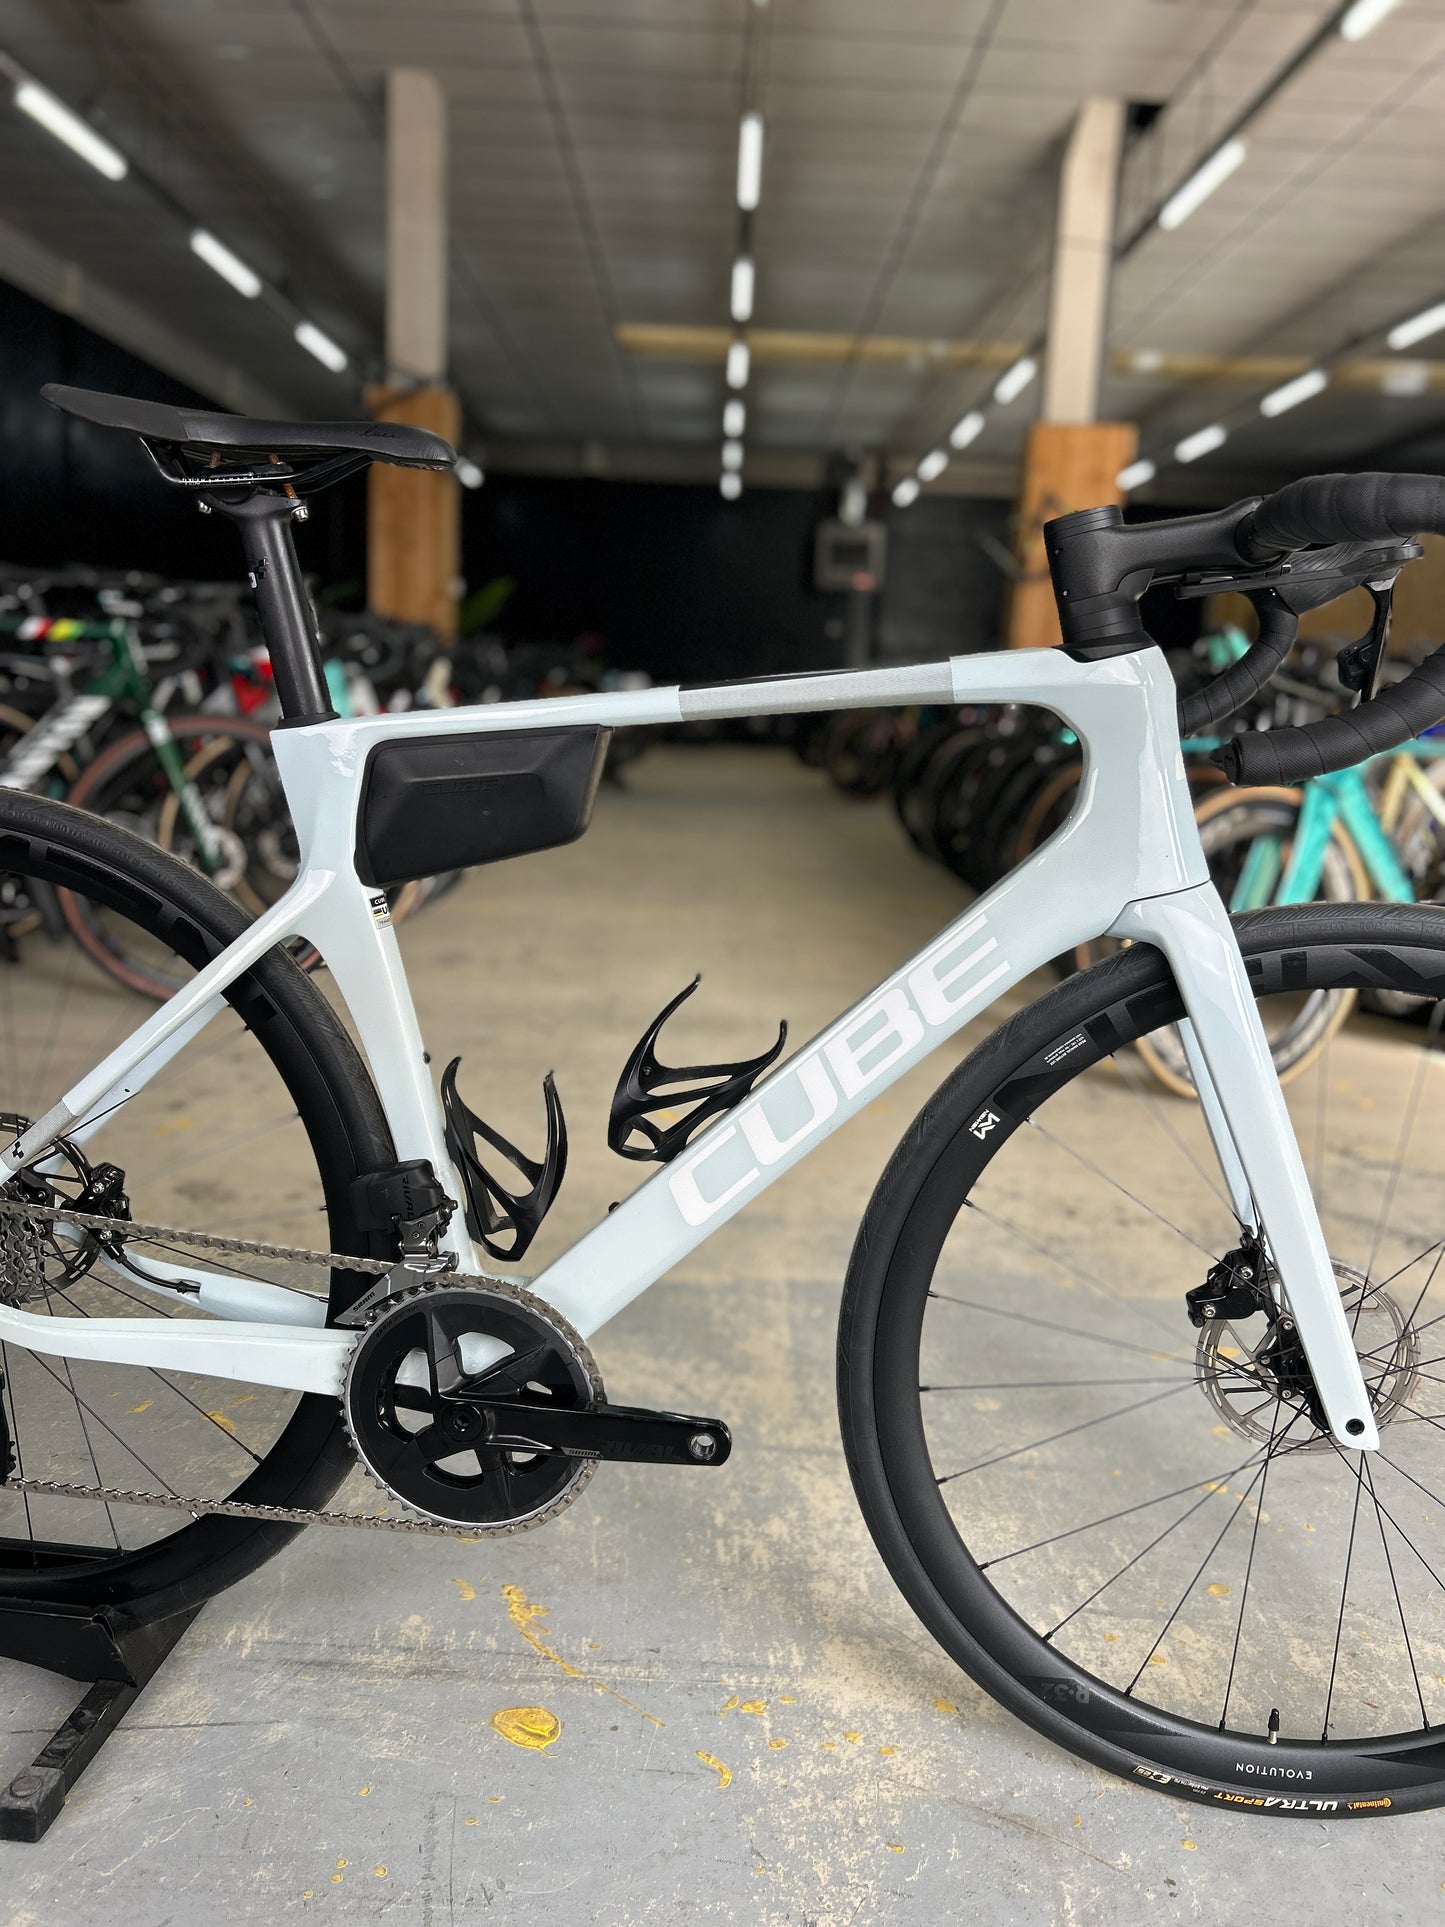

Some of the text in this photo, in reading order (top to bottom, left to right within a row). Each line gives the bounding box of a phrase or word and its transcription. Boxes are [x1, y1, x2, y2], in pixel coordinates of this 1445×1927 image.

[669, 913, 1011, 1226] CUBE
[1235, 1762, 1313, 1781] EVOLUTION
[1352, 1797, 1392, 1810] Continental
